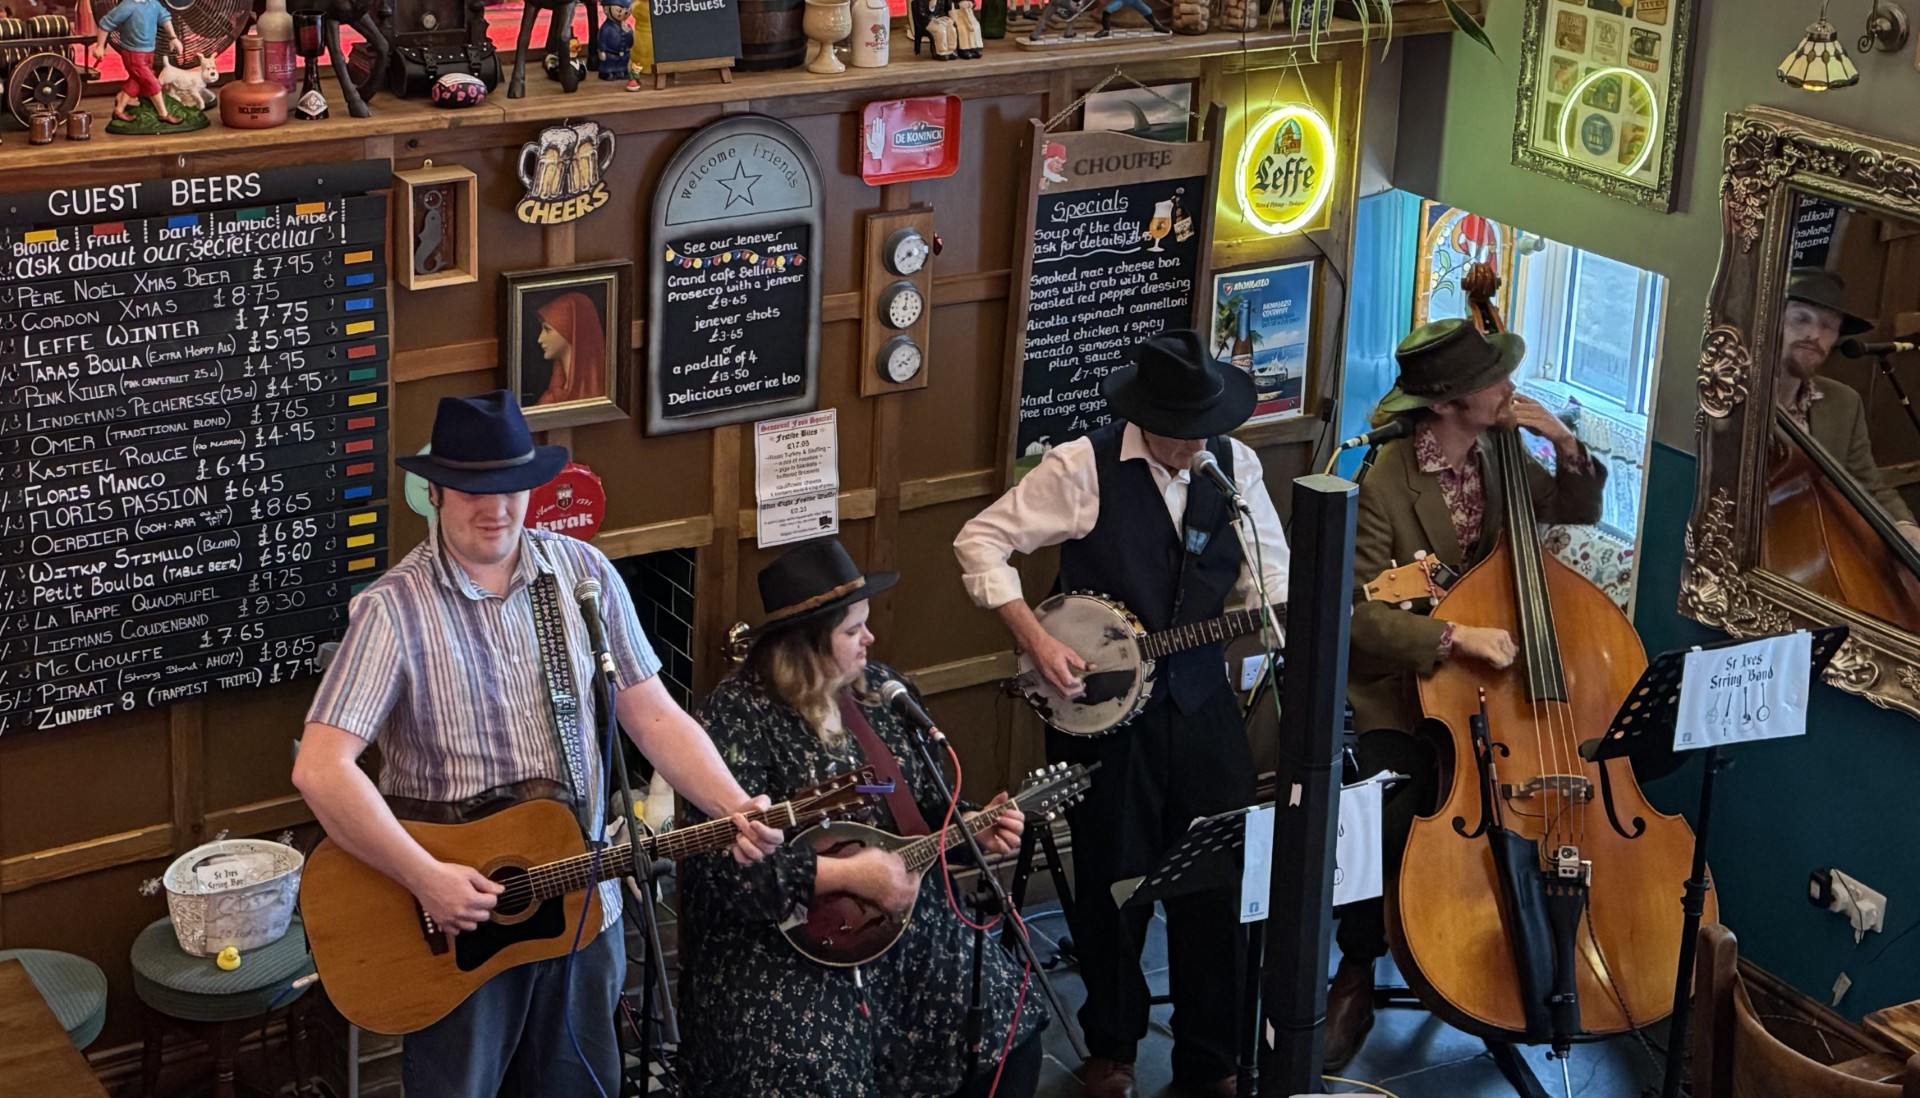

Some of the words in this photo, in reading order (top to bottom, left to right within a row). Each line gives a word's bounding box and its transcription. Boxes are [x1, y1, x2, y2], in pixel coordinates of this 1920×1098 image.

[895, 134, 906, 144] DE
[907, 129, 943, 143] KONINCK
[1074, 149, 1173, 176] CHOUFFE
[1251, 155, 1315, 198] Leffe
[48, 183, 142, 216] GUEST
[171, 172, 261, 206] BEERS
[518, 182, 609, 224] CHEERS
[1051, 189, 1129, 223] Specials
[13, 236, 70, 257] Blonde
[159, 224, 204, 241] Dark
[218, 216, 277, 235] Lambic
[285, 209, 338, 227] Amber
[1034, 226, 1070, 244] Soup
[1073, 223, 1087, 241] of
[1089, 220, 1110, 234] the
[1113, 217, 1140, 235] day
[68, 246, 136, 272] about
[143, 242, 189, 262] our
[190, 233, 252, 258] secret
[258, 227, 323, 250] cellar
[684, 242, 706, 255] See
[710, 239, 733, 251] our
[767, 242, 798, 254] menu
[1060, 239, 1078, 256] for
[1080, 233, 1127, 249] details)
[183, 267, 231, 287] BEER
[668, 270, 706, 288] Grand
[710, 268, 736, 285] cafe
[726, 279, 752, 292] with
[764, 274, 804, 291] jenever
[1030, 267, 1077, 287] Smoked
[1080, 268, 1103, 279] mac
[1114, 261, 1154, 275] cheese
[1158, 257, 1181, 268] bon
[1028, 297, 1074, 313] roasted
[1077, 292, 1096, 305] red
[1099, 285, 1139, 304] pepper
[1141, 277, 1191, 294] dressing
[1030, 286, 1059, 301] bons
[1062, 282, 1087, 294] with
[1090, 278, 1117, 290] crab
[1120, 273, 1145, 286] with
[1149, 272, 1159, 281] a
[21, 310, 100, 331] GORDON
[693, 313, 741, 332] jenever
[746, 307, 781, 322] shots
[1027, 313, 1069, 331] Ricotta
[1078, 306, 1124, 326] spinach
[1130, 294, 1188, 314] cannelloni
[24, 333, 95, 359] LEFFE
[106, 319, 200, 347] WINTER
[1073, 324, 1119, 341] chicken
[1132, 317, 1165, 332] spicy
[673, 366, 681, 375] a
[685, 354, 731, 375] paddle
[735, 351, 747, 369] of
[749, 350, 758, 363] 4
[723, 344, 736, 354] or
[1049, 358, 1079, 372] plum
[1084, 350, 1122, 364] sauce
[20, 360, 80, 383] TARAS
[85, 354, 142, 375] BOULA
[17, 385, 66, 408] PINK
[668, 383, 732, 405] Delicious
[735, 380, 762, 394] over
[765, 376, 779, 388] ice
[782, 373, 801, 386] too
[1021, 389, 1053, 407] Hand
[1056, 382, 1100, 400] carved
[27, 406, 127, 432] LINDEMANS
[1043, 403, 1076, 417] range
[1079, 398, 1107, 413] eggs
[31, 435, 96, 456] OMER
[29, 459, 117, 482] KASTEEL
[120, 446, 188, 468] ROUGE
[24, 484, 91, 508] FLORIS
[99, 472, 165, 495] MANGO
[30, 500, 113, 533] FLORIS
[122, 485, 208, 517] PASSION
[31, 528, 129, 556] OERBIER
[29, 562, 107, 584] WITKAP
[114, 545, 194, 569] STIMULO
[33, 583, 83, 606] Petit
[91, 572, 155, 597] Boulba
[63, 603, 121, 624] TRAPPE
[34, 631, 113, 656] LIEFMANS
[75, 647, 163, 673] CHOUFFE
[1725, 656, 1738, 671] St
[1740, 653, 1763, 668] Ives
[1710, 672, 1742, 690] String
[1747, 665, 1774, 682] Band
[37, 678, 108, 705] PIRAAT
[34, 703, 114, 730] ZUNDERT
[122, 691, 136, 711] 8
